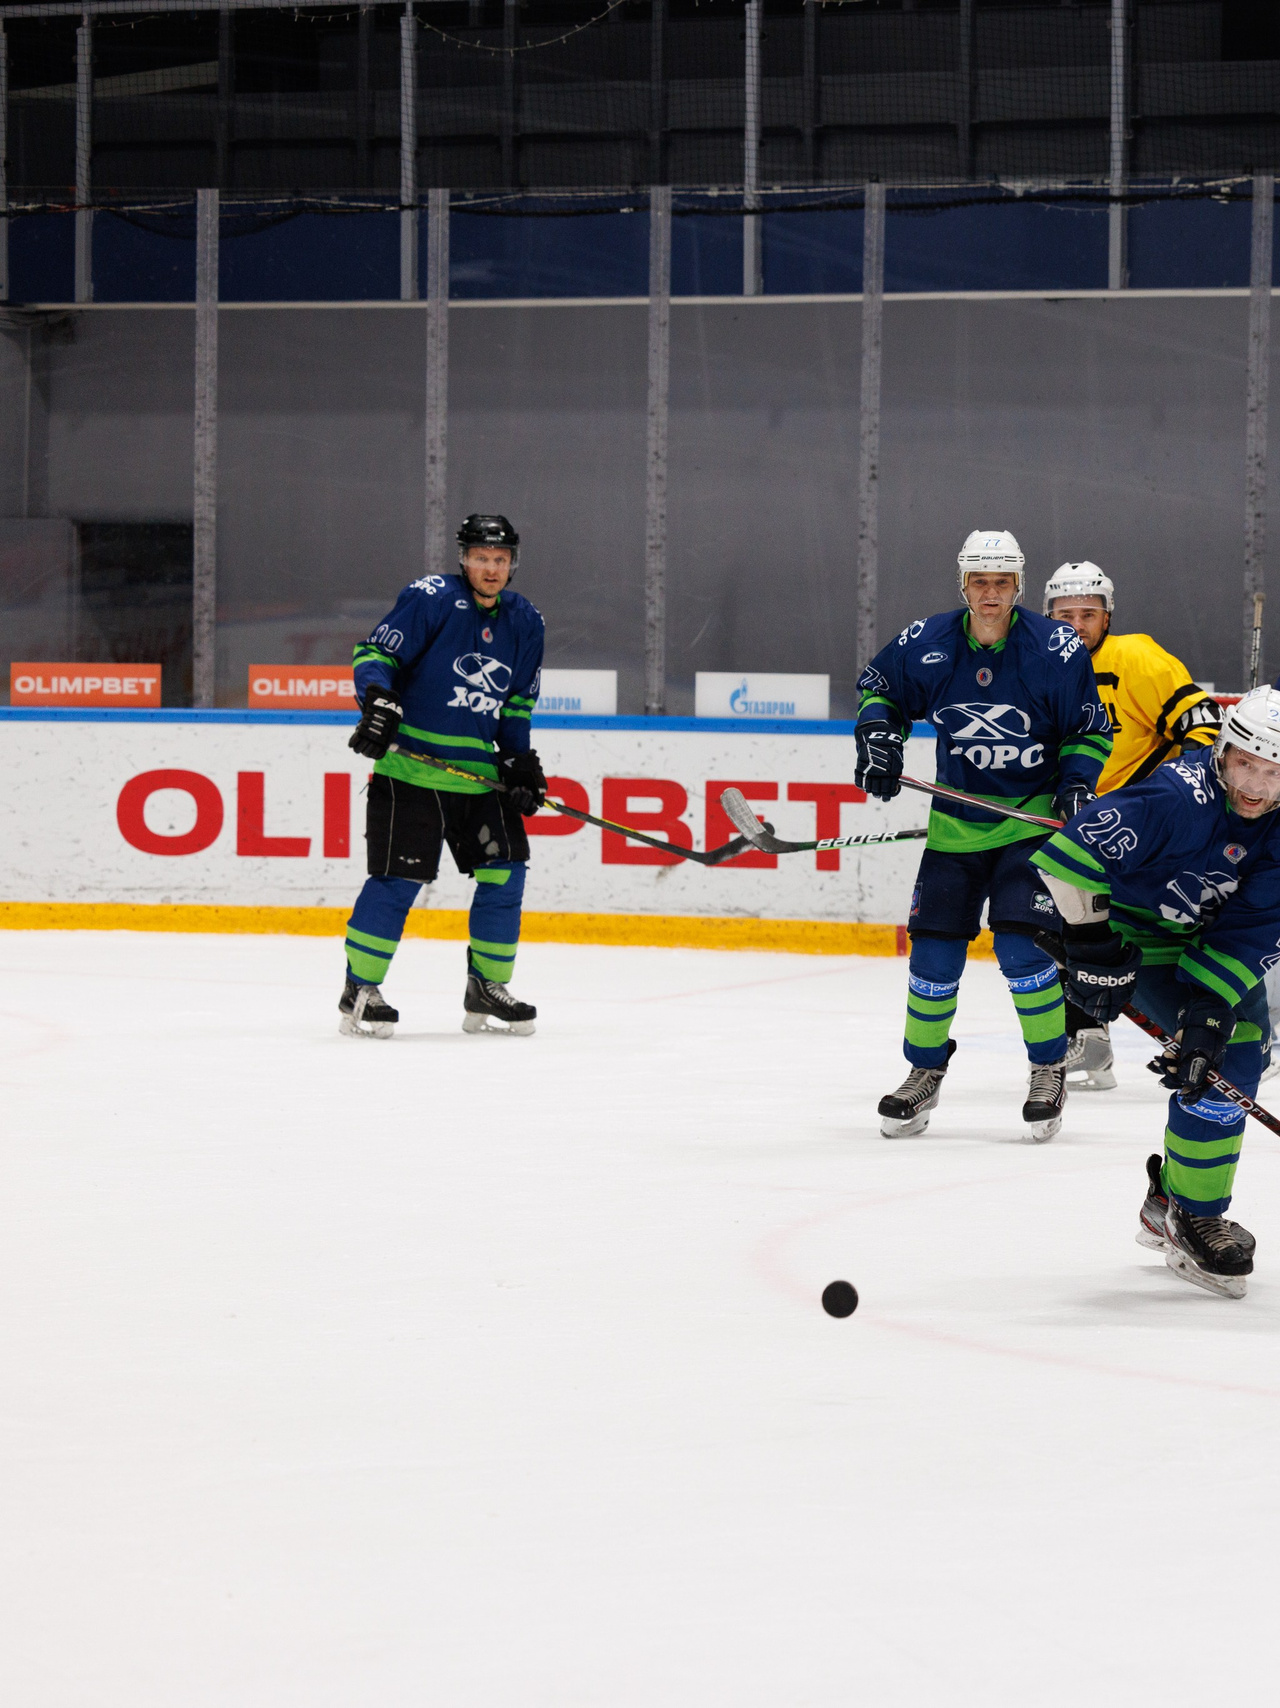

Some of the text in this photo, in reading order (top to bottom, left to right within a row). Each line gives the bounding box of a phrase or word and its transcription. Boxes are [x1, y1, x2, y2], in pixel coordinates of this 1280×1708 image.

[14, 676, 157, 696] OLIMPBET
[252, 678, 357, 698] OLIMPB
[538, 696, 581, 711] АЗПРОМ
[949, 742, 1045, 770] ОРС
[116, 768, 867, 872] OLIPBET
[1077, 807, 1139, 860] 26
[1076, 969, 1137, 988] Reebok
